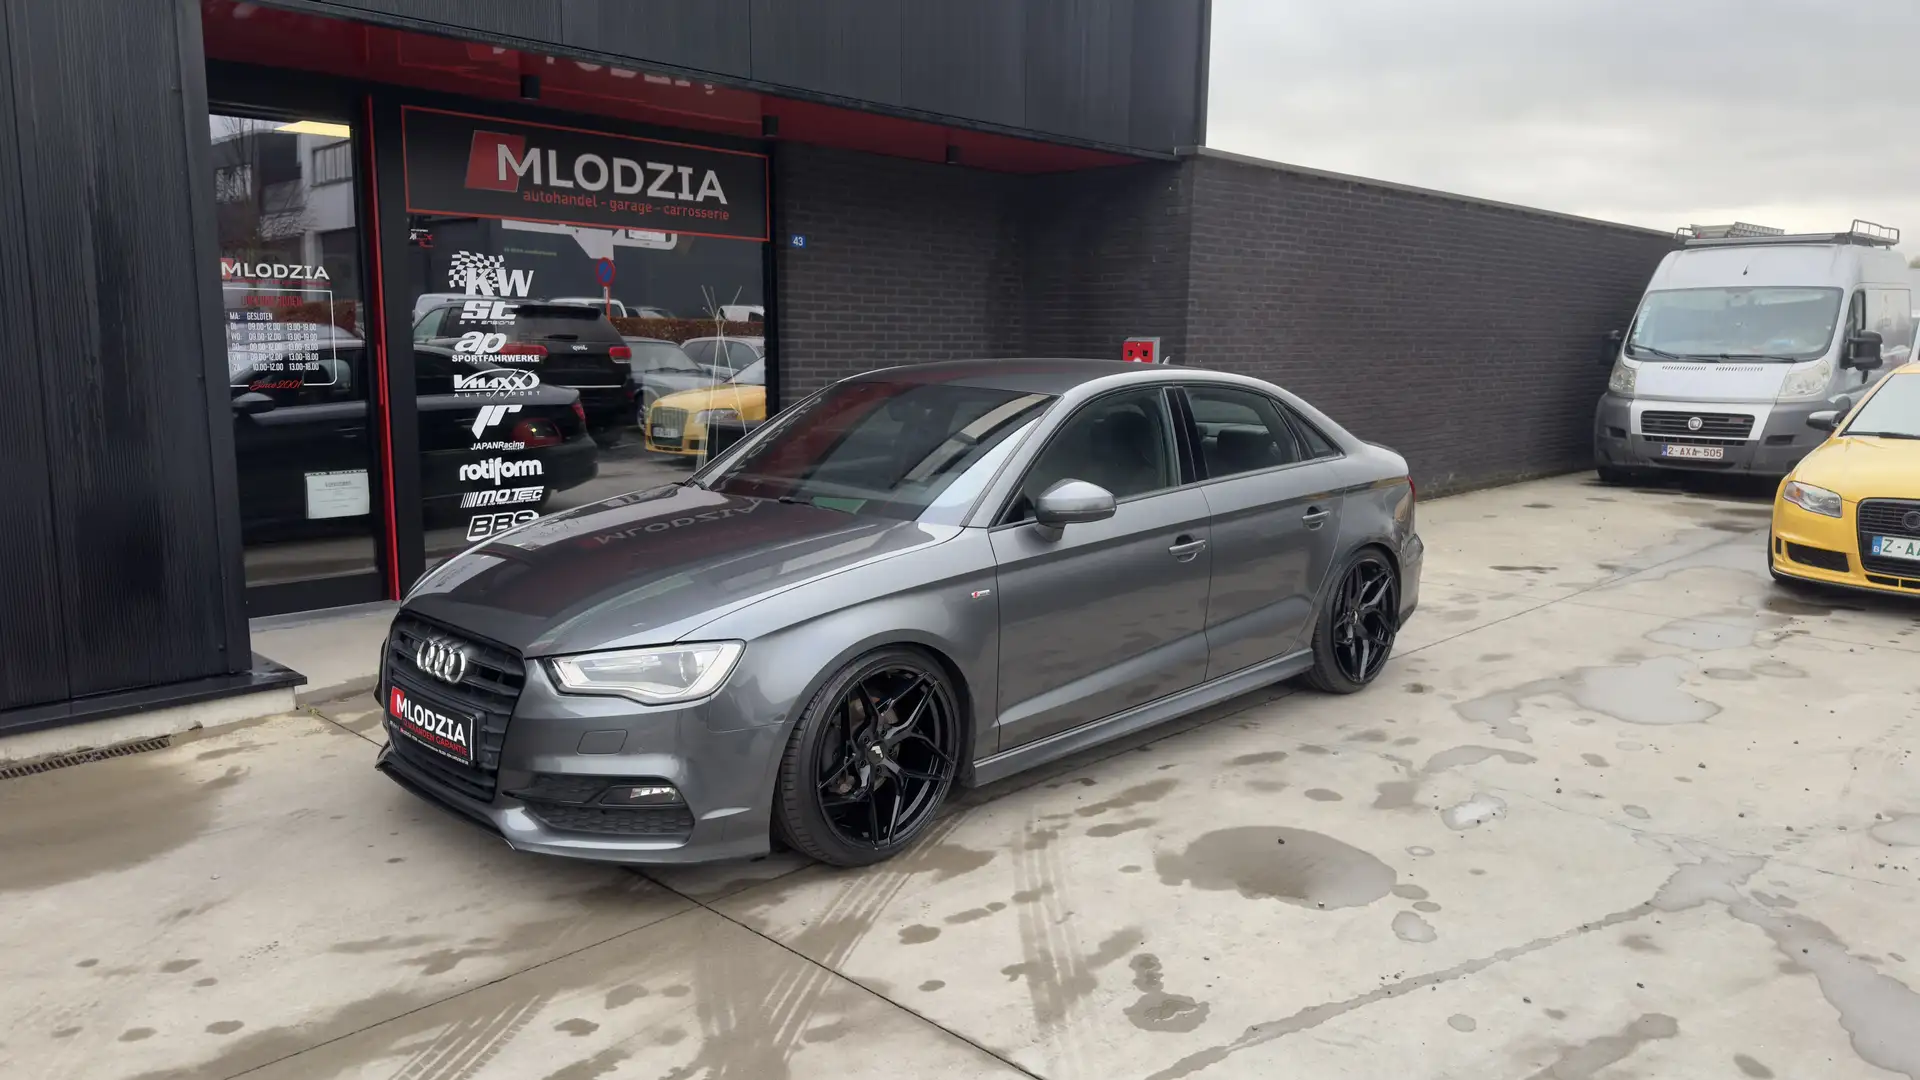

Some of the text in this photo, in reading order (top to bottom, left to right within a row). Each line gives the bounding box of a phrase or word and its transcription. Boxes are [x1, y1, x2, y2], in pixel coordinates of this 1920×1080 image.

[497, 143, 728, 205] MLODZIA
[523, 188, 598, 208] autohandel
[609, 198, 653, 215] garage
[663, 199, 729, 221] carrosserie
[793, 236, 803, 246] 43
[221, 261, 330, 280] MLODZIA
[465, 267, 534, 297] KW
[246, 312, 273, 321] GESLOTEN
[454, 331, 507, 355] ap
[452, 354, 540, 363] SPORTFAHRWERKE
[250, 379, 303, 391] Since 2001
[459, 457, 542, 486] rotiform
[1883, 539, 1920, 556] Z-A
[396, 693, 467, 747] MLODZIA
